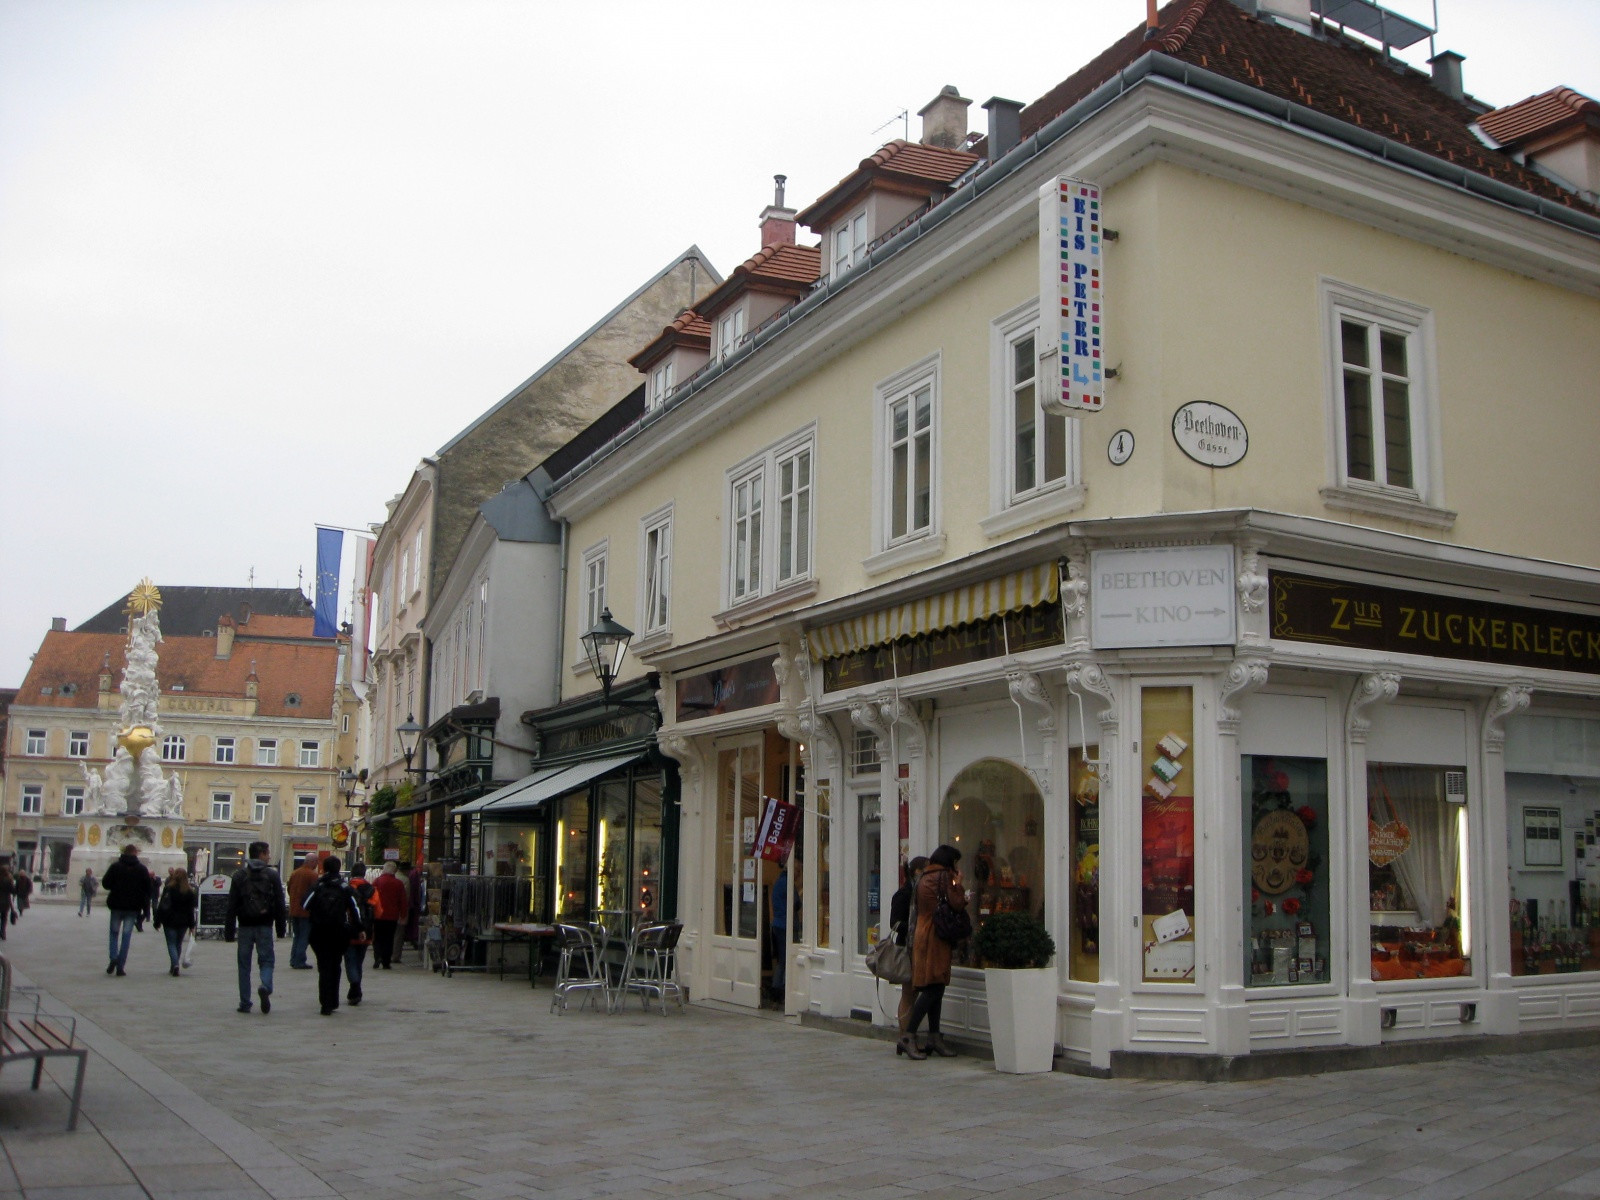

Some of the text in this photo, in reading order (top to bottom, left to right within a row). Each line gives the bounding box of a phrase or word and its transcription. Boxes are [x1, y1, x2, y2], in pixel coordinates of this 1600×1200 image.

[1074, 198, 1089, 356] EIS PETER
[1116, 434, 1125, 454] 4
[1101, 568, 1225, 591] BEETHOVEN
[1135, 605, 1192, 625] KINO
[168, 698, 233, 712] CENTRAL
[767, 808, 787, 845] Baden
